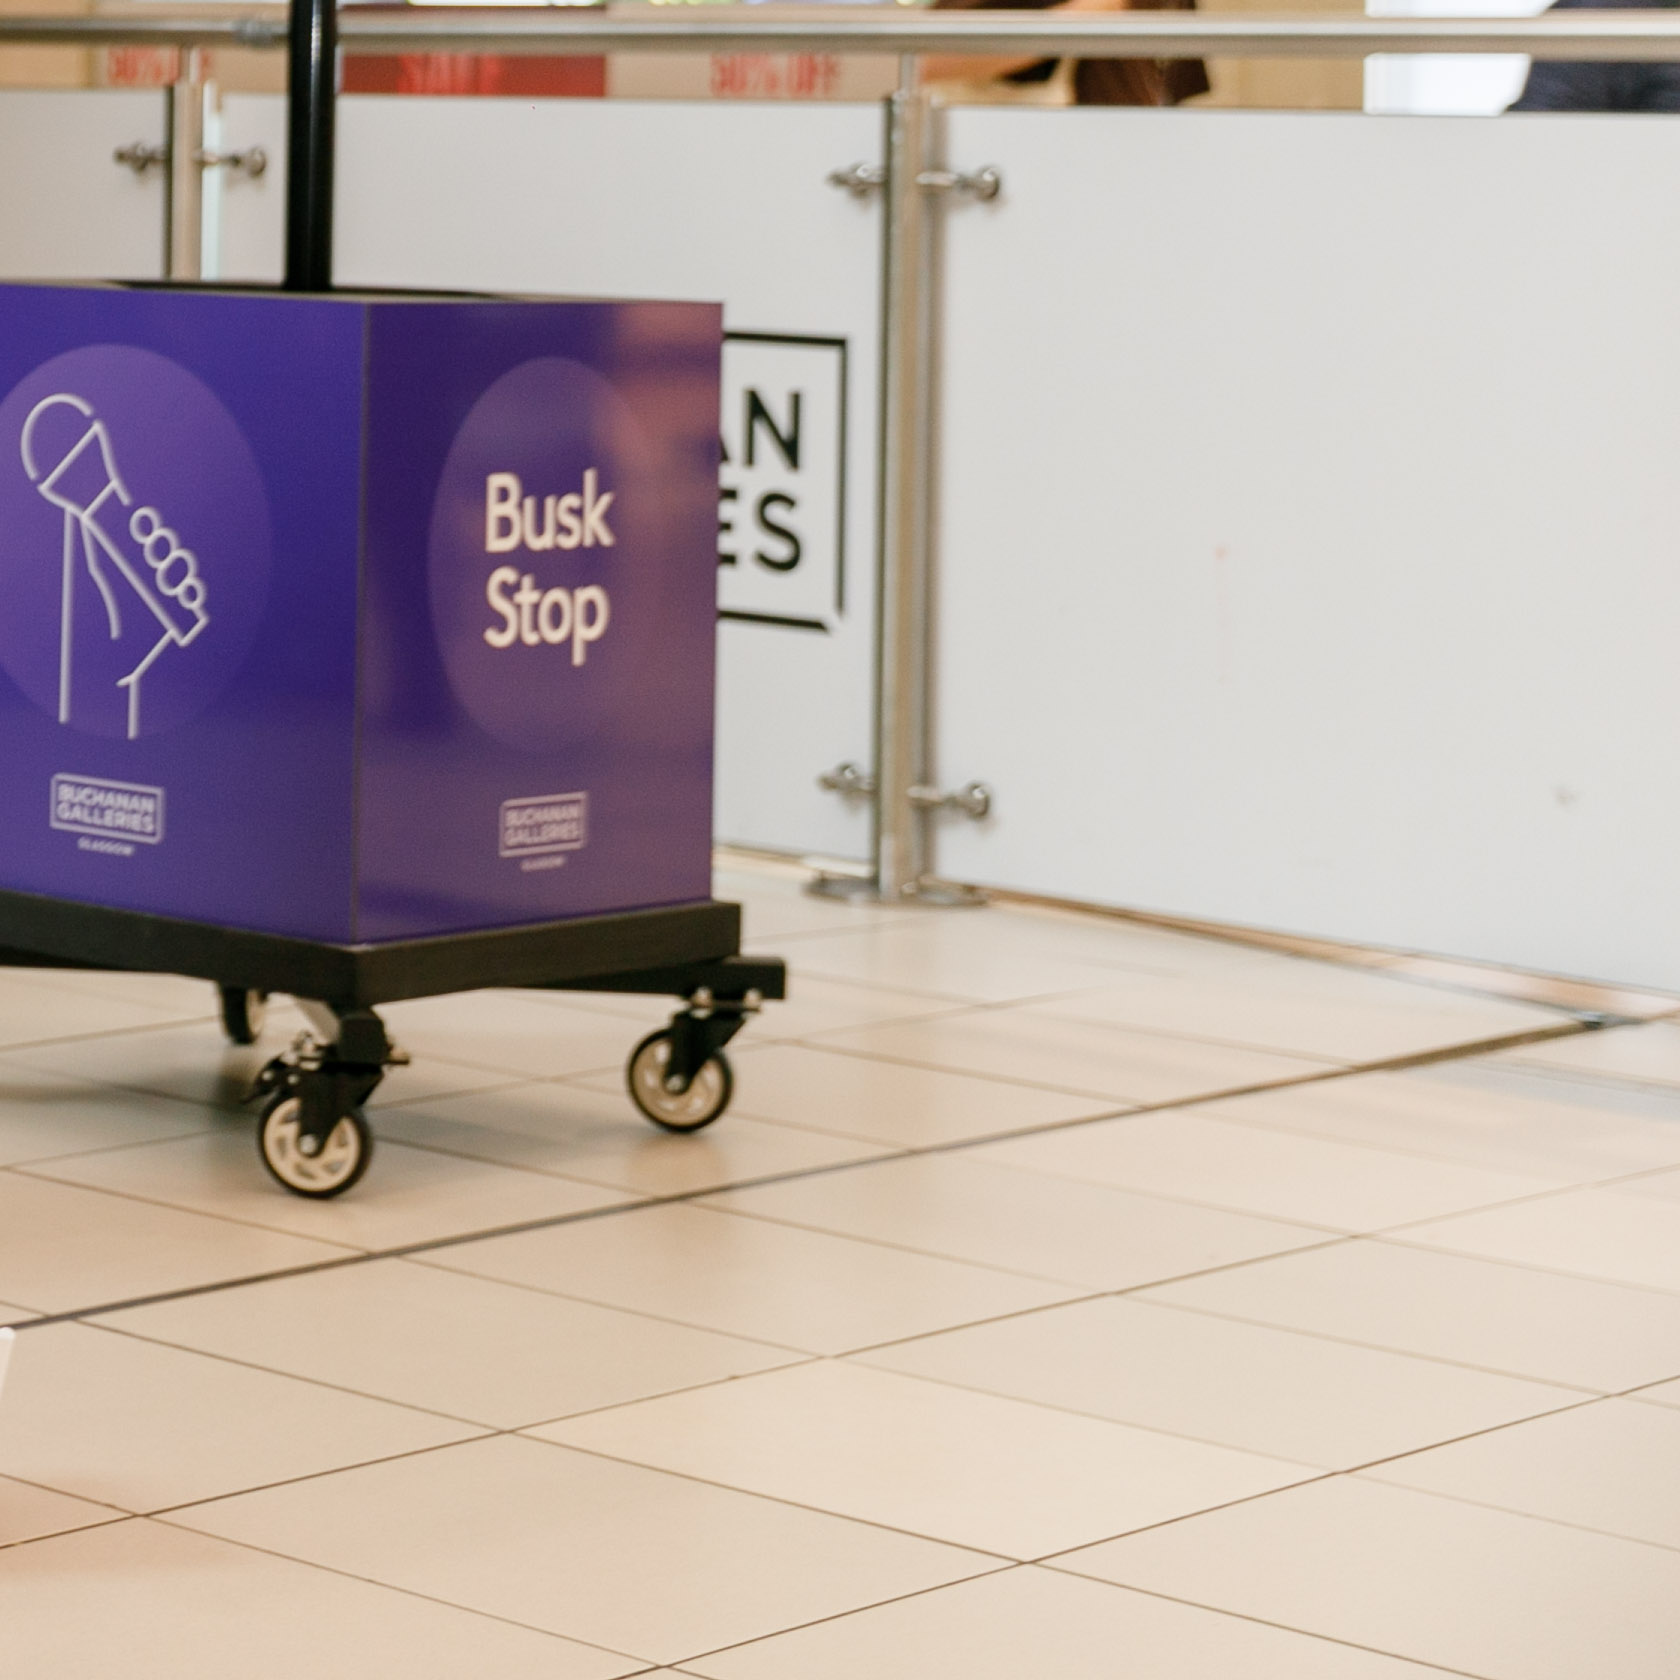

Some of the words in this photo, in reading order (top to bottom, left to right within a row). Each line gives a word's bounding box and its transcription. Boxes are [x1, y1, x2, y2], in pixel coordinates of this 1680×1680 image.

[484, 467, 616, 553] Busk
[483, 565, 611, 667] Stop
[56, 801, 155, 833] GALLERIES
[58, 783, 155, 814] BUCHANAN
